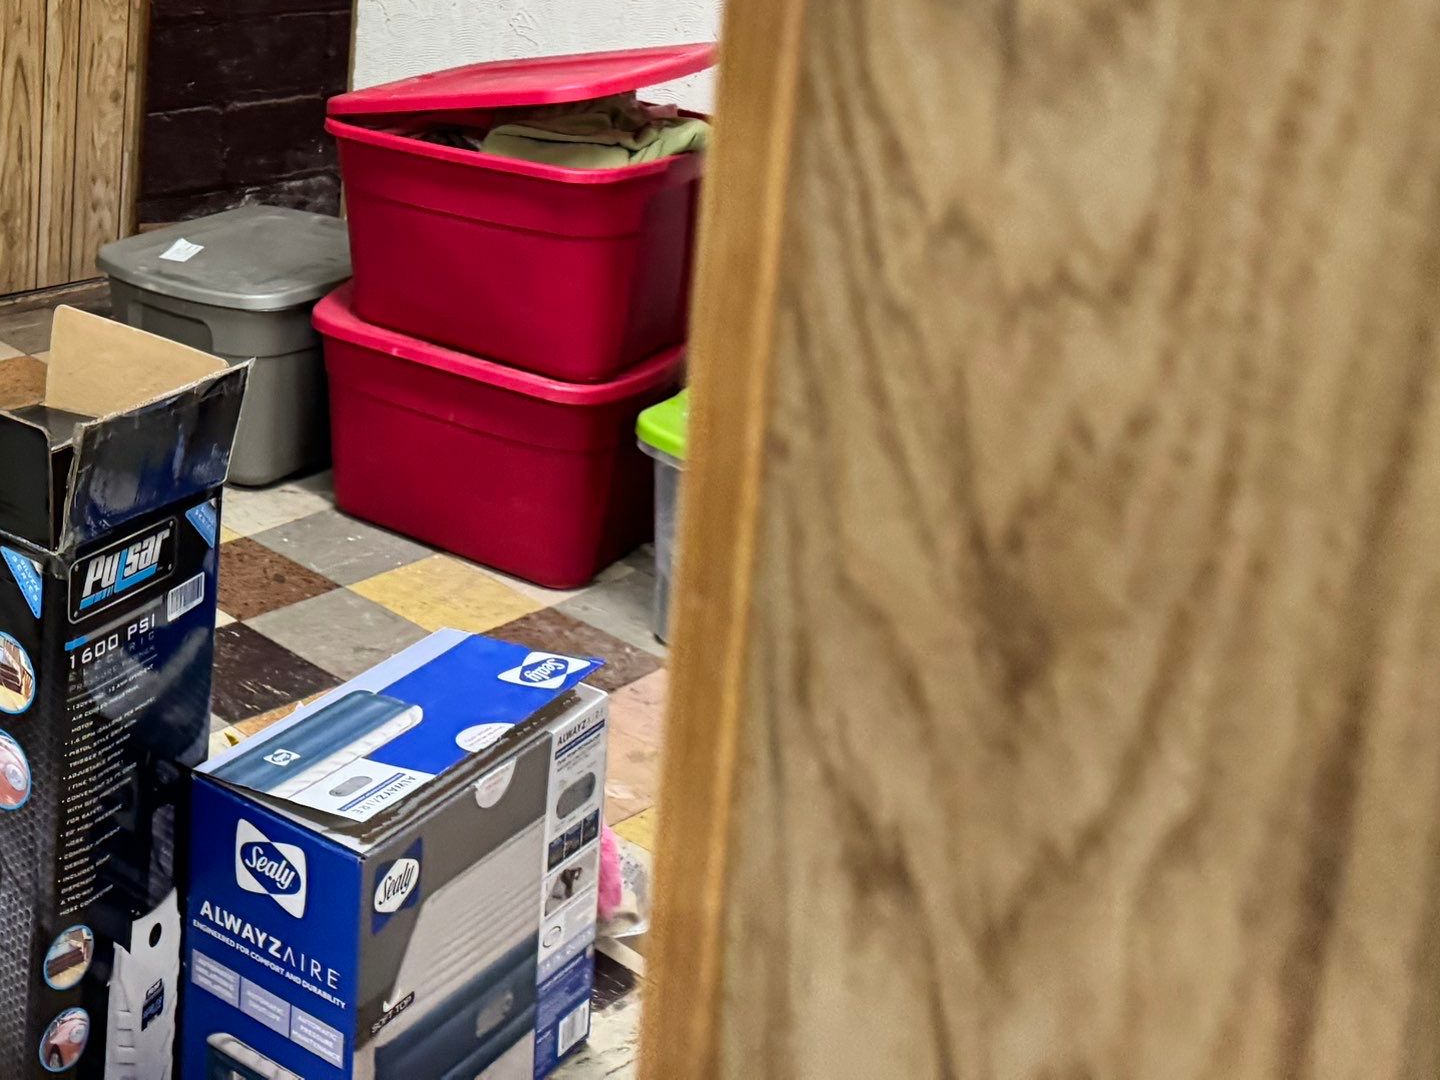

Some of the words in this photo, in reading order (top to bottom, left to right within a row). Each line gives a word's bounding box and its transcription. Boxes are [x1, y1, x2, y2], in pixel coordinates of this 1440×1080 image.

[69, 633, 119, 670] 1600
[127, 612, 156, 641] PSI
[523, 657, 566, 683] Sealy
[71, 720, 94, 733] MOTOR
[67, 758, 106, 780] ADJUSTABLE
[244, 845, 296, 891] Sealy
[378, 861, 415, 906] Sealy
[192, 918, 235, 948] ENGINEERED
[235, 942, 251, 956] FOR
[250, 950, 285, 979] COMFORT
[284, 969, 302, 986] AND
[301, 978, 347, 1010] DURABILITY
